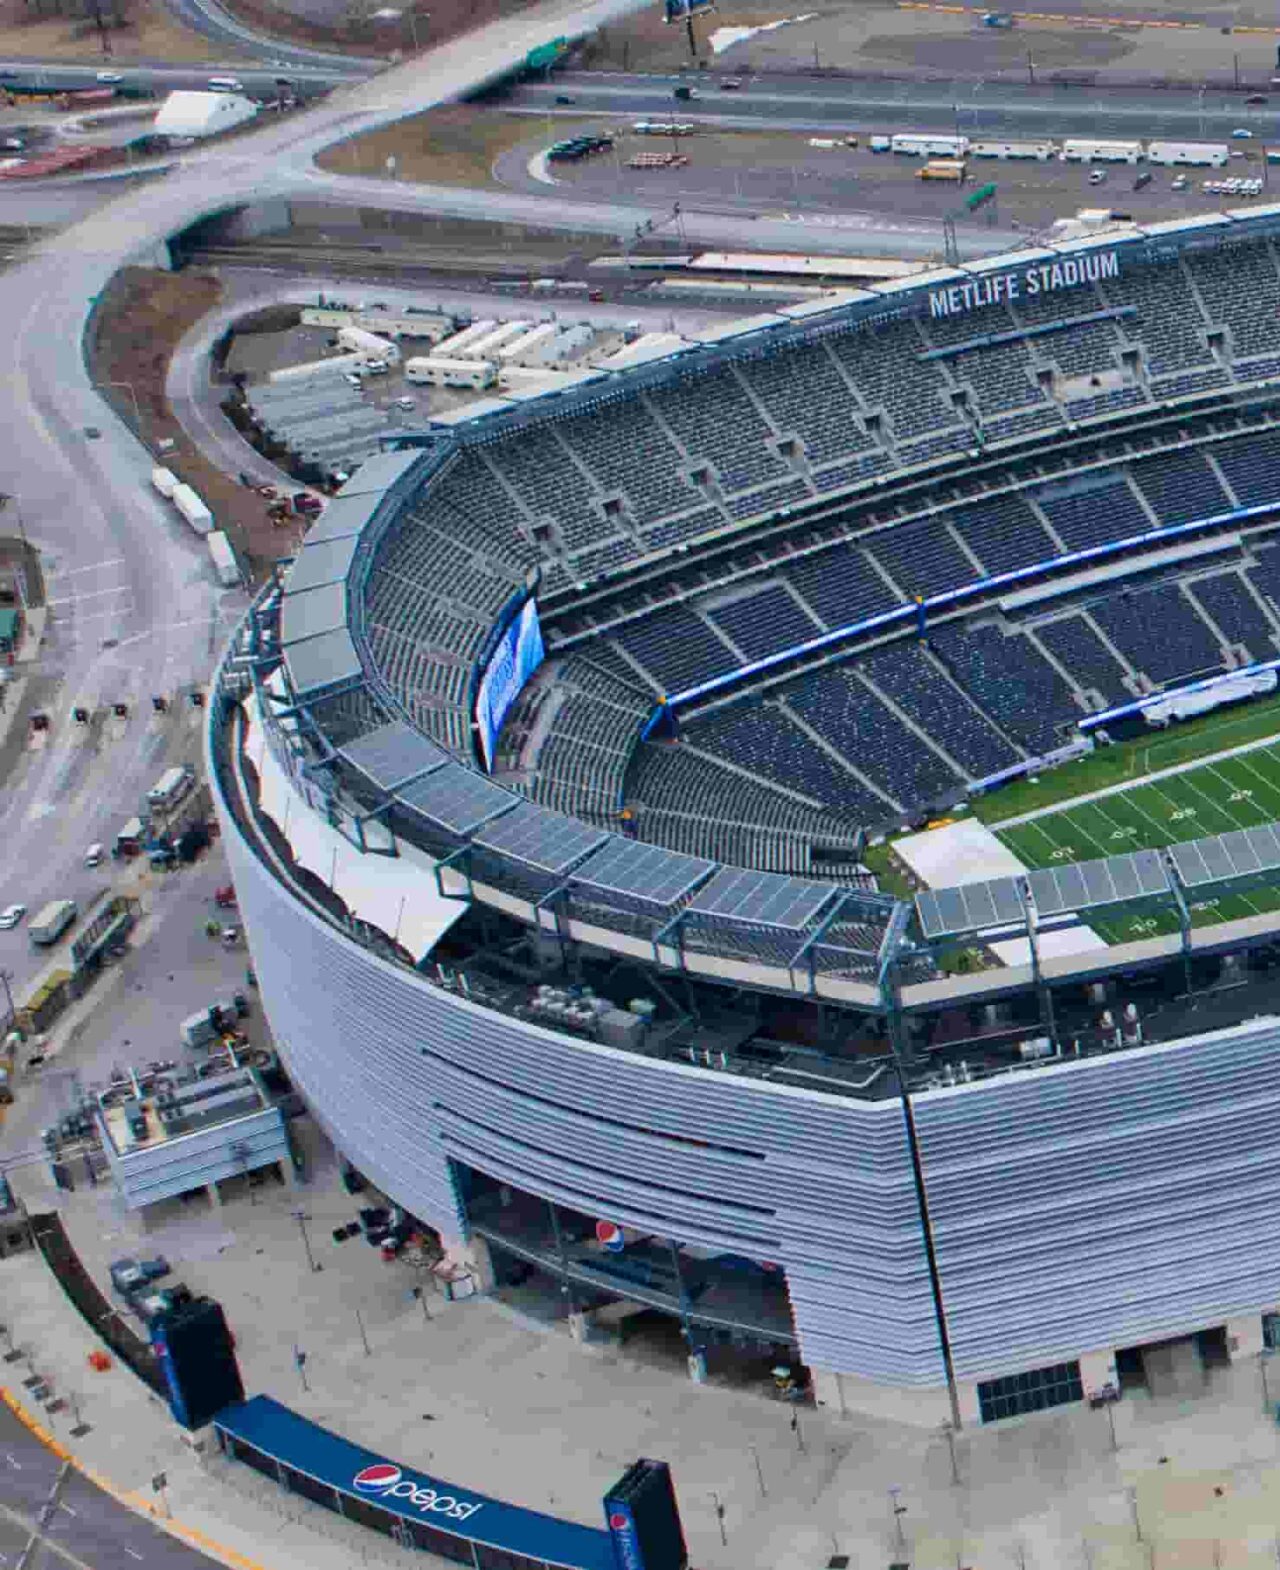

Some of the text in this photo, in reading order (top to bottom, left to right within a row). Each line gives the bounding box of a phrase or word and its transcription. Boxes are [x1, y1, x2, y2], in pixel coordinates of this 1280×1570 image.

[929, 252, 1119, 319] METLIFE STADIUM
[382, 1481, 483, 1520] pepsi
